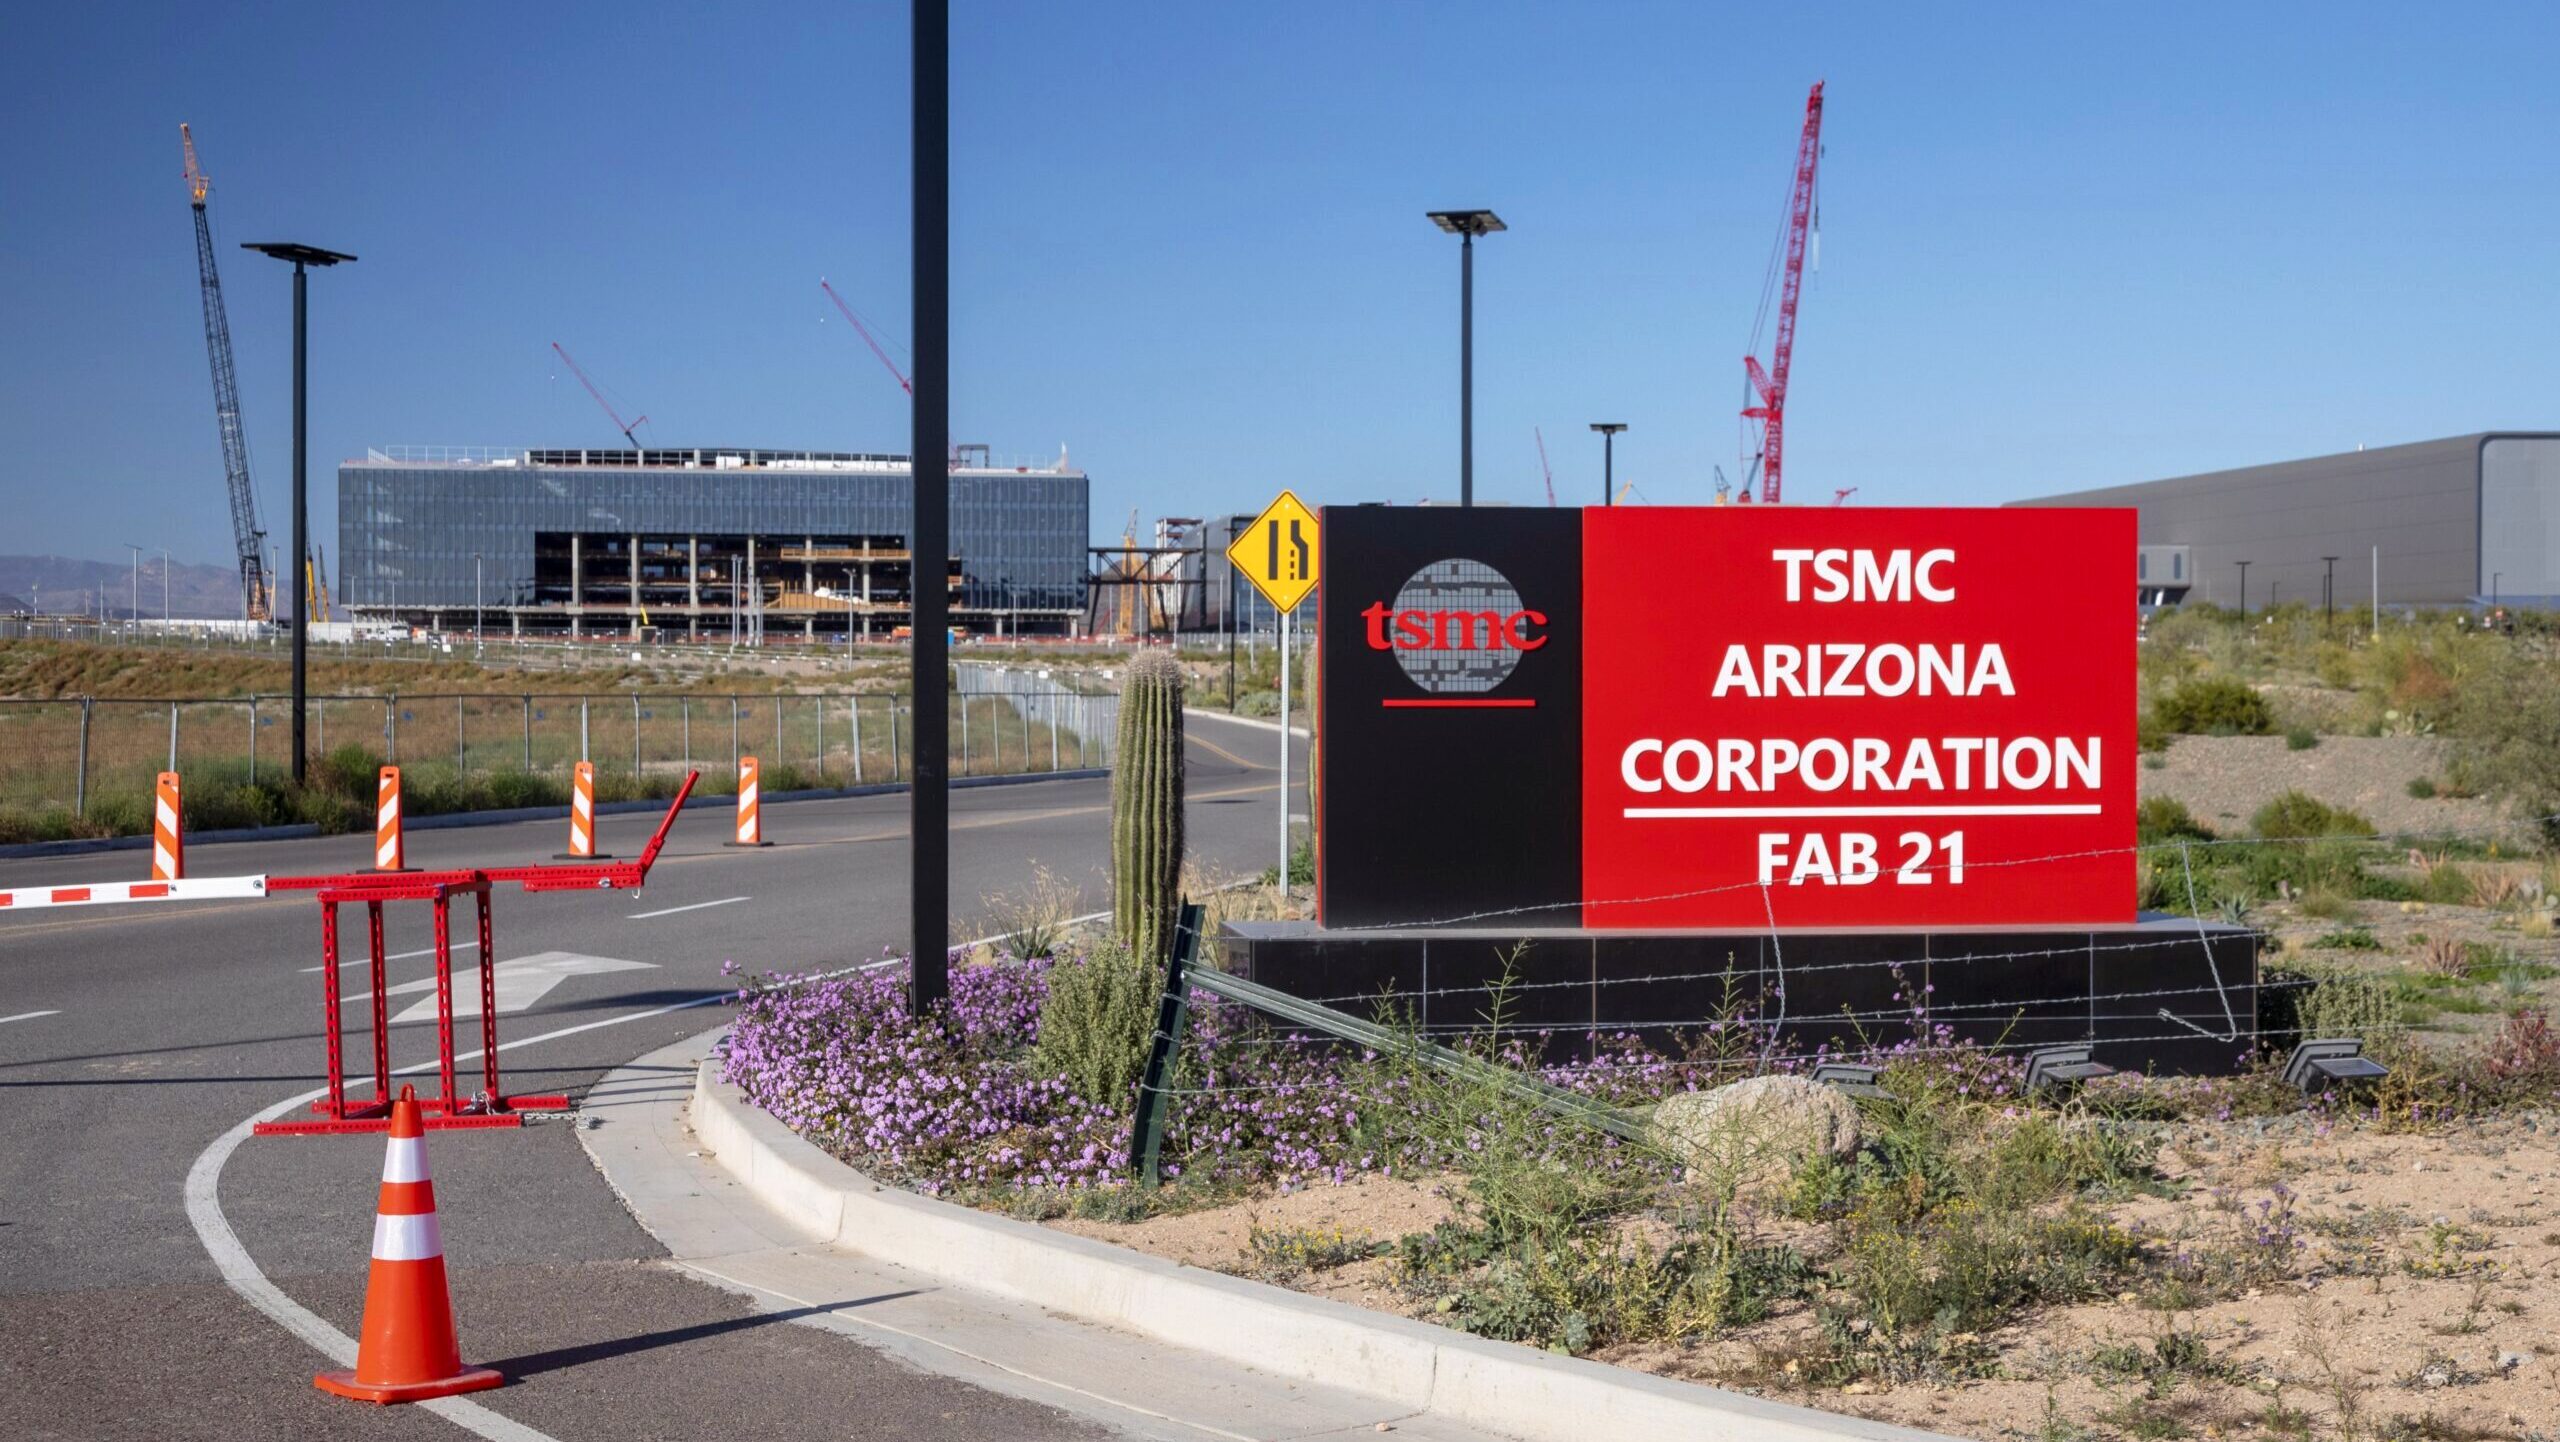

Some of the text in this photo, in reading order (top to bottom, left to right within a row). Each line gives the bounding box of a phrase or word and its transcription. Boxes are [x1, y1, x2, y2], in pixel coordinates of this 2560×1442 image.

[1772, 548, 1956, 604] TSMC
[1361, 601, 1548, 652] tsmc
[1711, 643, 2017, 698] ARIZONA
[1620, 736, 2102, 794] CORPORATION
[1758, 830, 1965, 888] FAB 21
